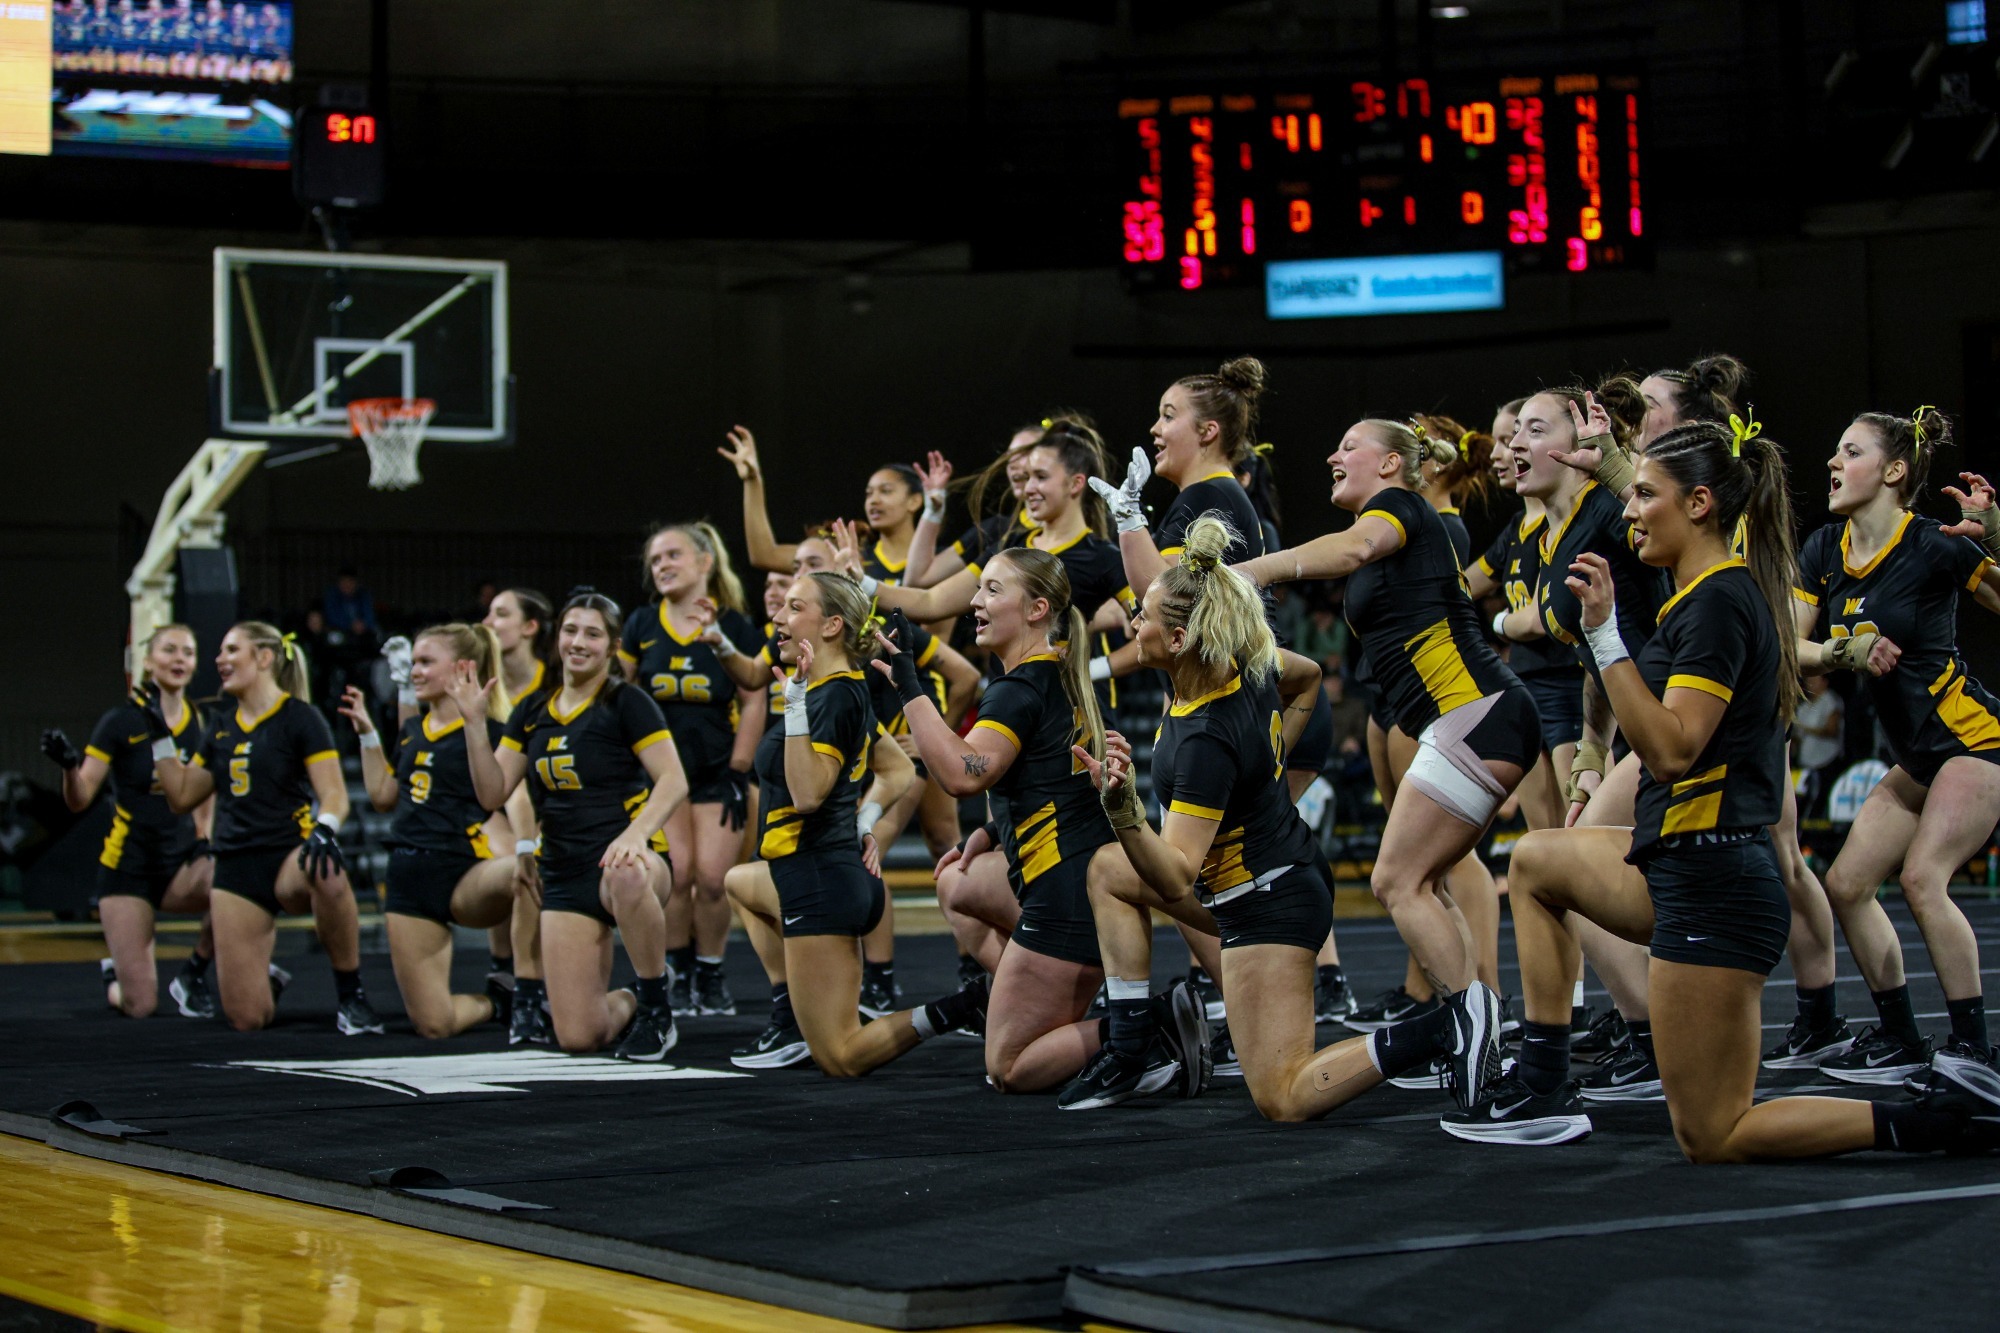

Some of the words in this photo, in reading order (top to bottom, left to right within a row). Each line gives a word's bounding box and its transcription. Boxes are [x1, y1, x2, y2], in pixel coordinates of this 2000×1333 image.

[1271, 113, 1322, 152] 41
[1445, 102, 1497, 144] 40
[1289, 199, 1311, 233] 0
[1461, 191, 1483, 224] 0
[1843, 596, 1866, 617] WL
[651, 673, 712, 703] 26
[229, 757, 251, 797] 5
[535, 754, 583, 792] 15
